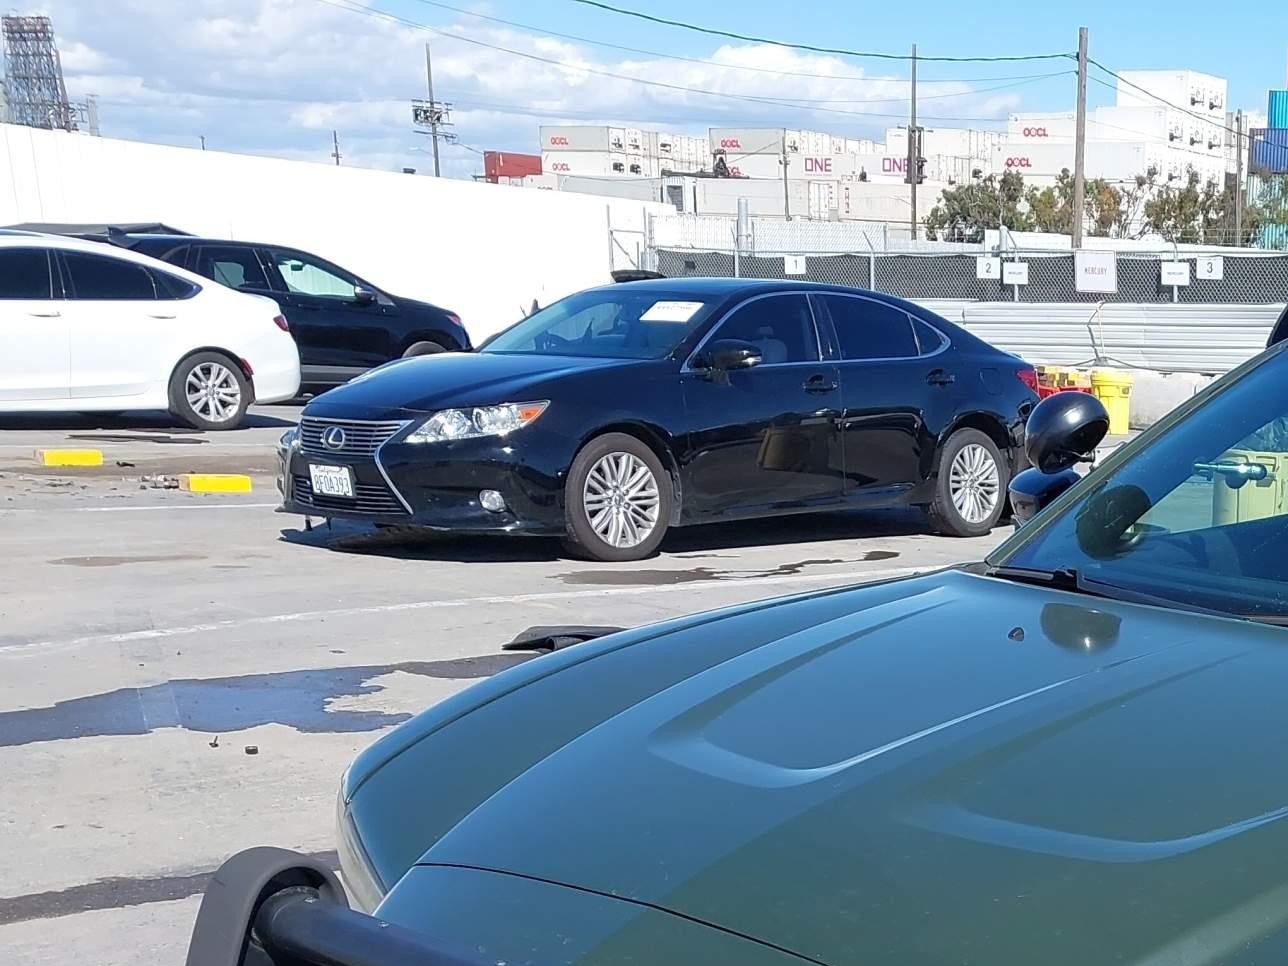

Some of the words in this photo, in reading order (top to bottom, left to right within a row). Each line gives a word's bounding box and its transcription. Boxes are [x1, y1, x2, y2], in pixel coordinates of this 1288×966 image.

[1023, 127, 1049, 138] OOCL
[550, 136, 569, 146] OOCL
[720, 139, 741, 148] OOCL
[804, 158, 832, 172] ONE
[1006, 157, 1032, 168] OOCL
[794, 259, 799, 269] 1
[985, 262, 992, 274] 2
[1206, 262, 1213, 274] 3
